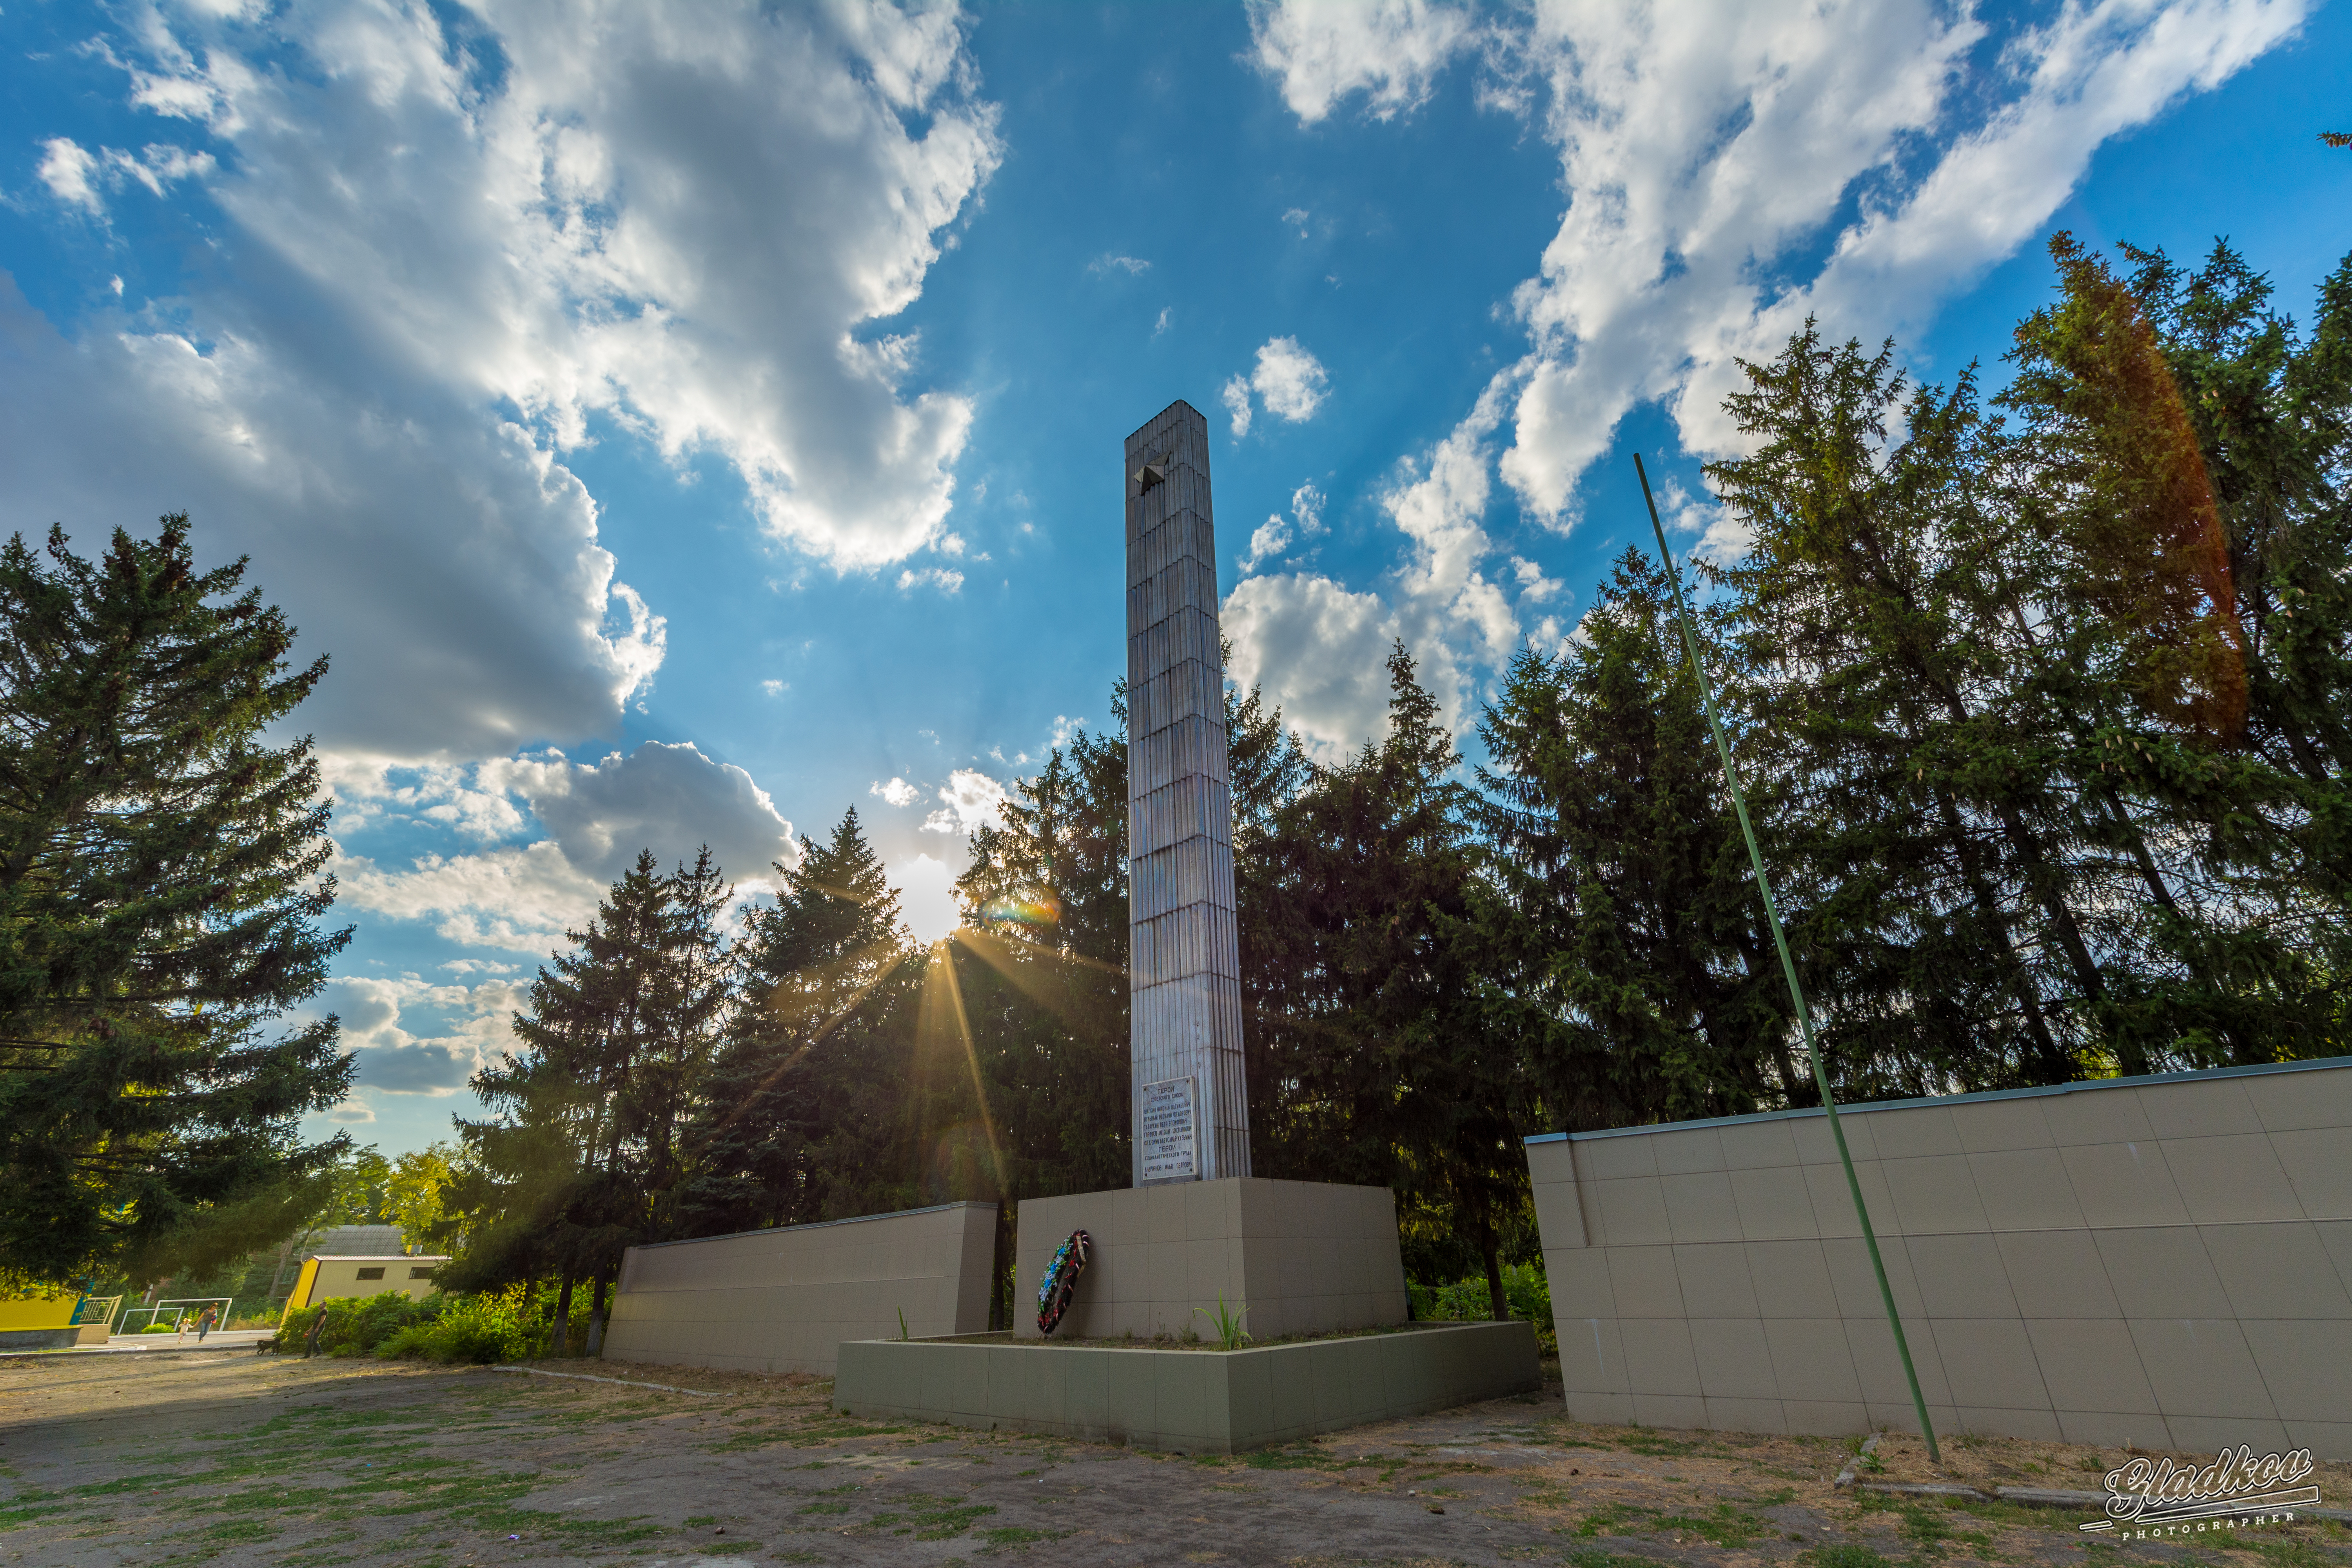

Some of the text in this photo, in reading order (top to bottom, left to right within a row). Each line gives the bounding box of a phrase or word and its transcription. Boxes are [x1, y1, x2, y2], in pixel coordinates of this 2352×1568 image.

[1158, 1086, 1174, 1094] ГЕРОИ
[1171, 1102, 1190, 1110] ВАСИЛЬЕВИЧ
[1159, 1112, 1172, 1120] ВАСИЛИЙ
[1159, 1143, 1176, 1152] ГЕРОЙ
[1145, 1152, 1179, 1161] СОЦИАЛИСТИЧЕСКОГО
